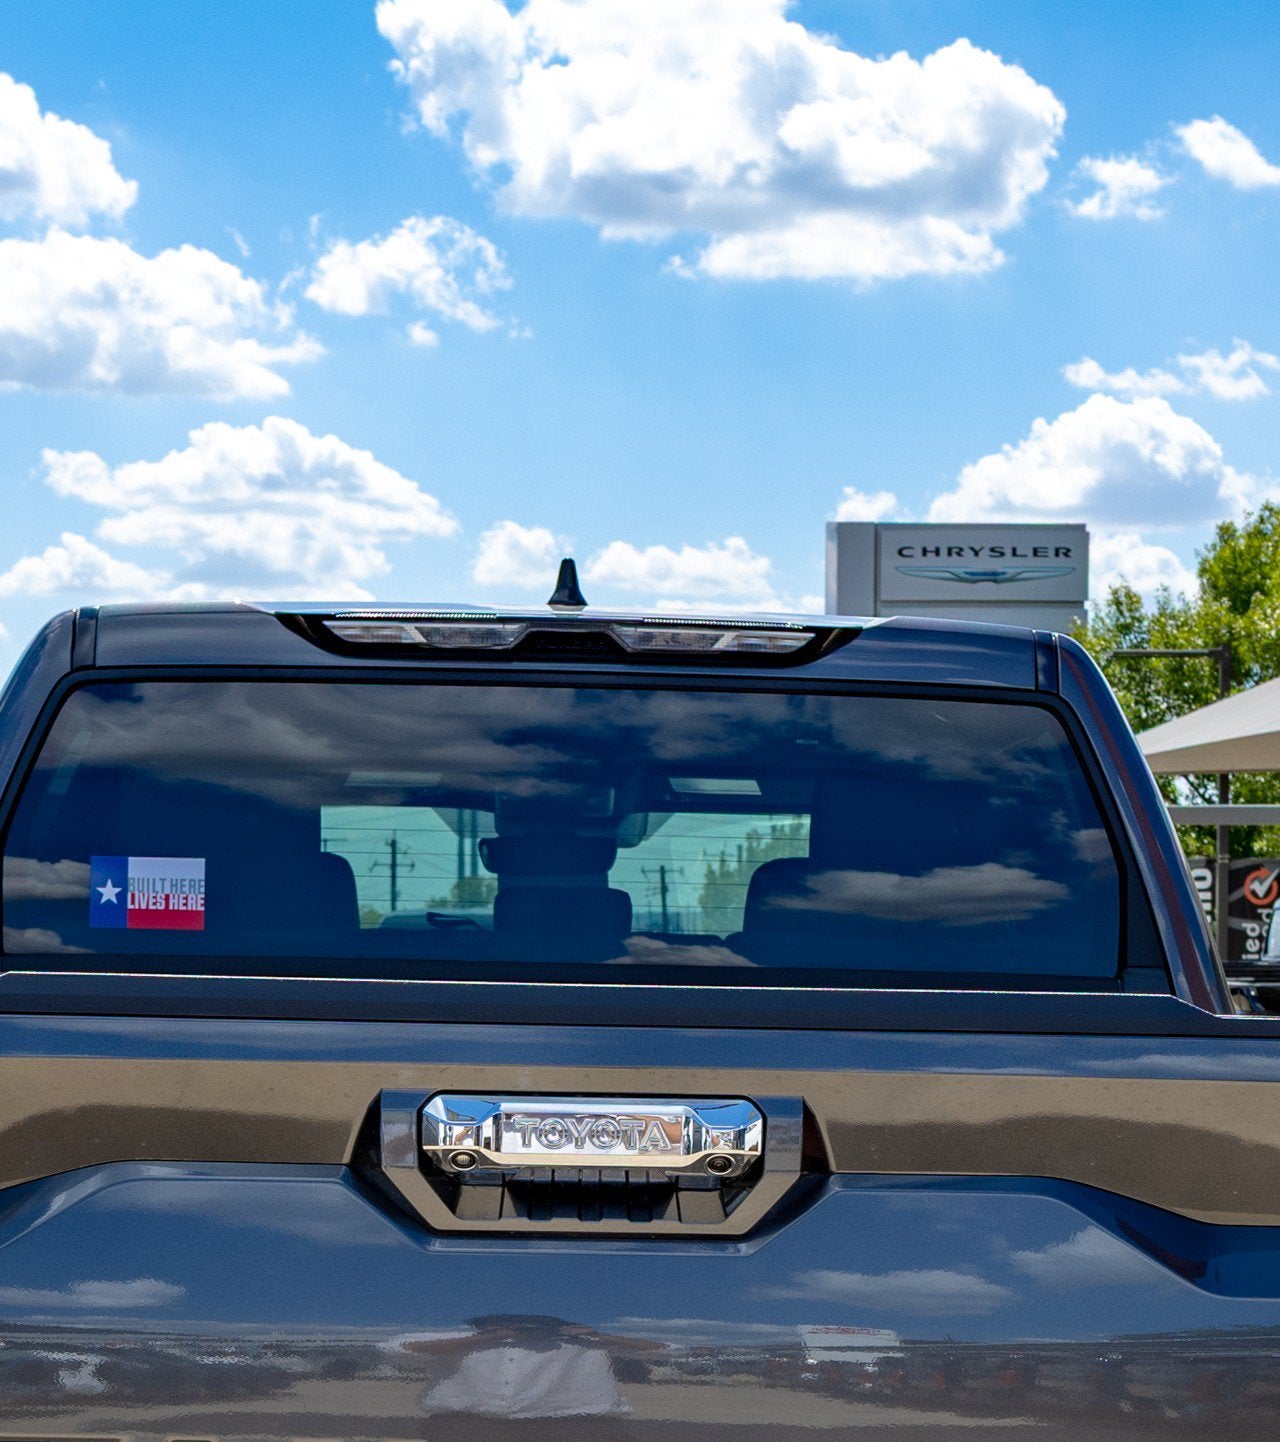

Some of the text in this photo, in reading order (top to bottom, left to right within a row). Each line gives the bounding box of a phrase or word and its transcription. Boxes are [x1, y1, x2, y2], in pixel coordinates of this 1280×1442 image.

[897, 546, 1073, 559] CHRYSLER
[128, 877, 205, 895] BUILT HERE
[127, 892, 205, 911] LIVES HERE
[514, 1117, 672, 1151] TOYOTA
